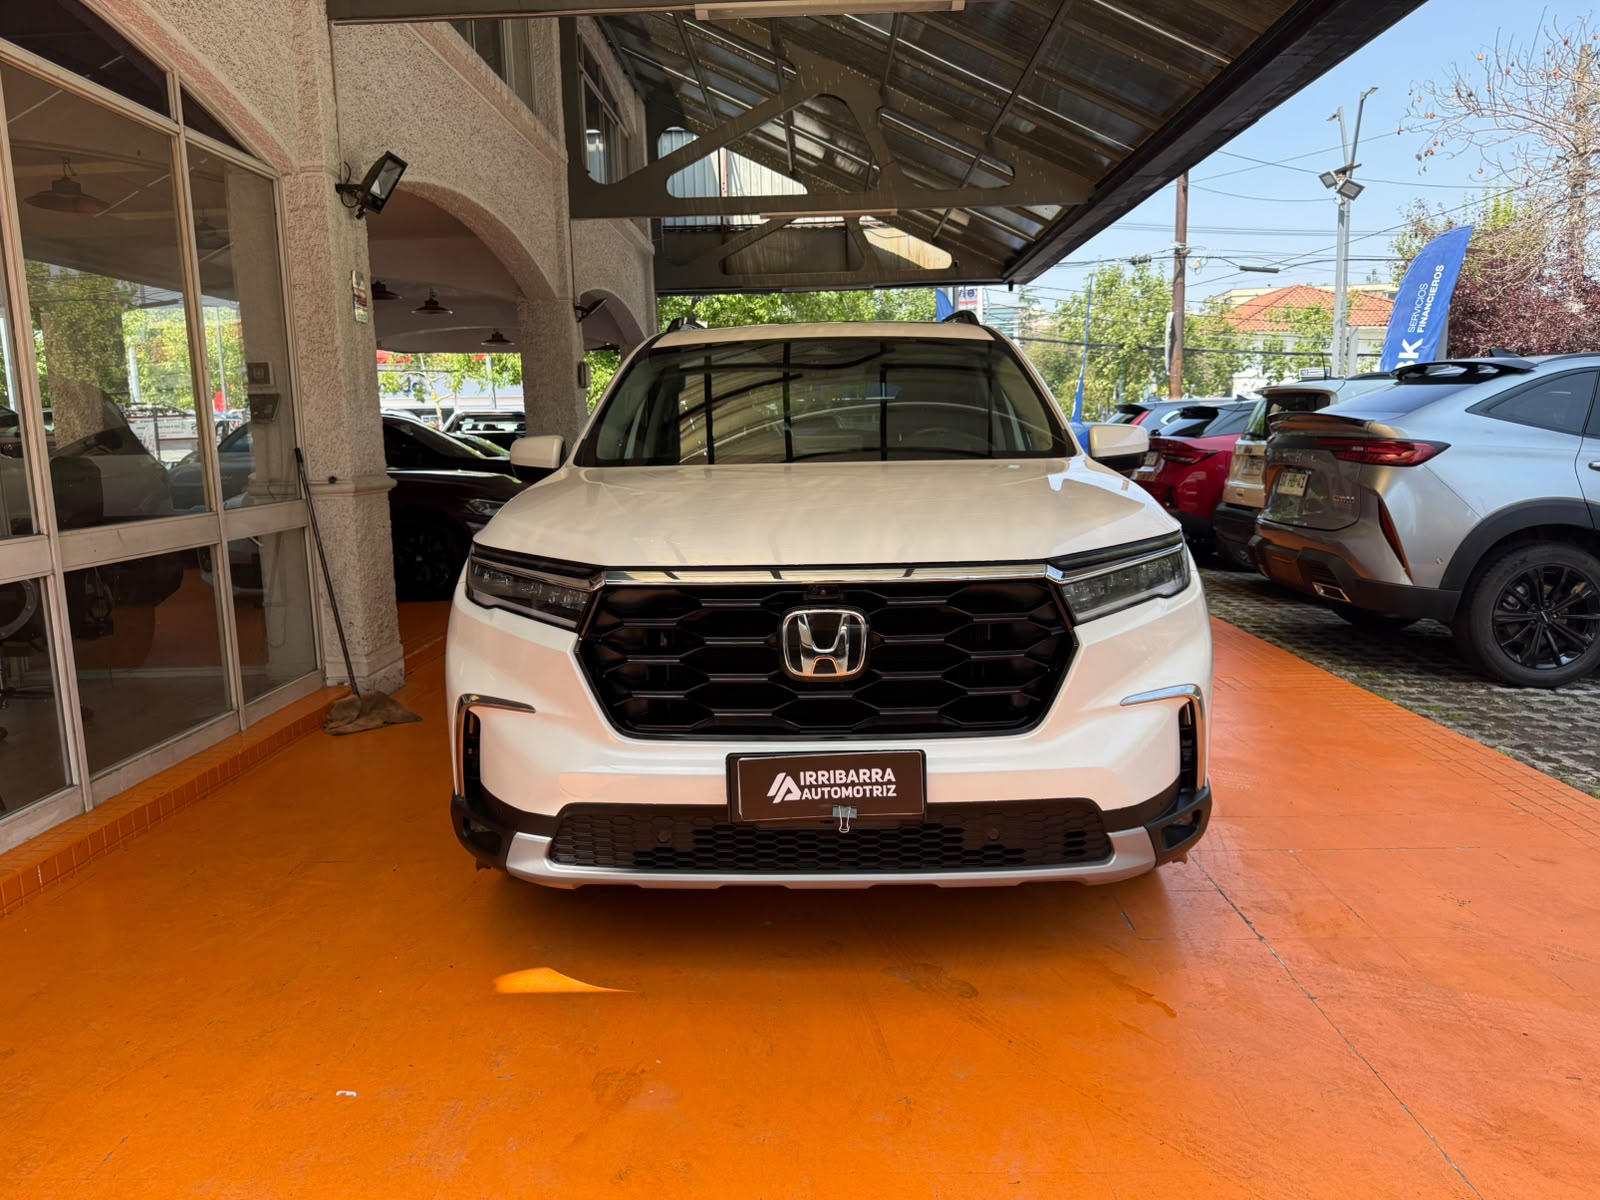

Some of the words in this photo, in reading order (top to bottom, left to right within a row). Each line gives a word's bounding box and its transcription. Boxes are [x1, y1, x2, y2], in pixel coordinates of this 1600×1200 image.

[1408, 283, 1429, 333] SERVICIOS
[1417, 264, 1445, 333] FINANCIEROS
[800, 768, 896, 786] IRRIBARRA
[801, 785, 897, 800] AUTOMOTRIZ
